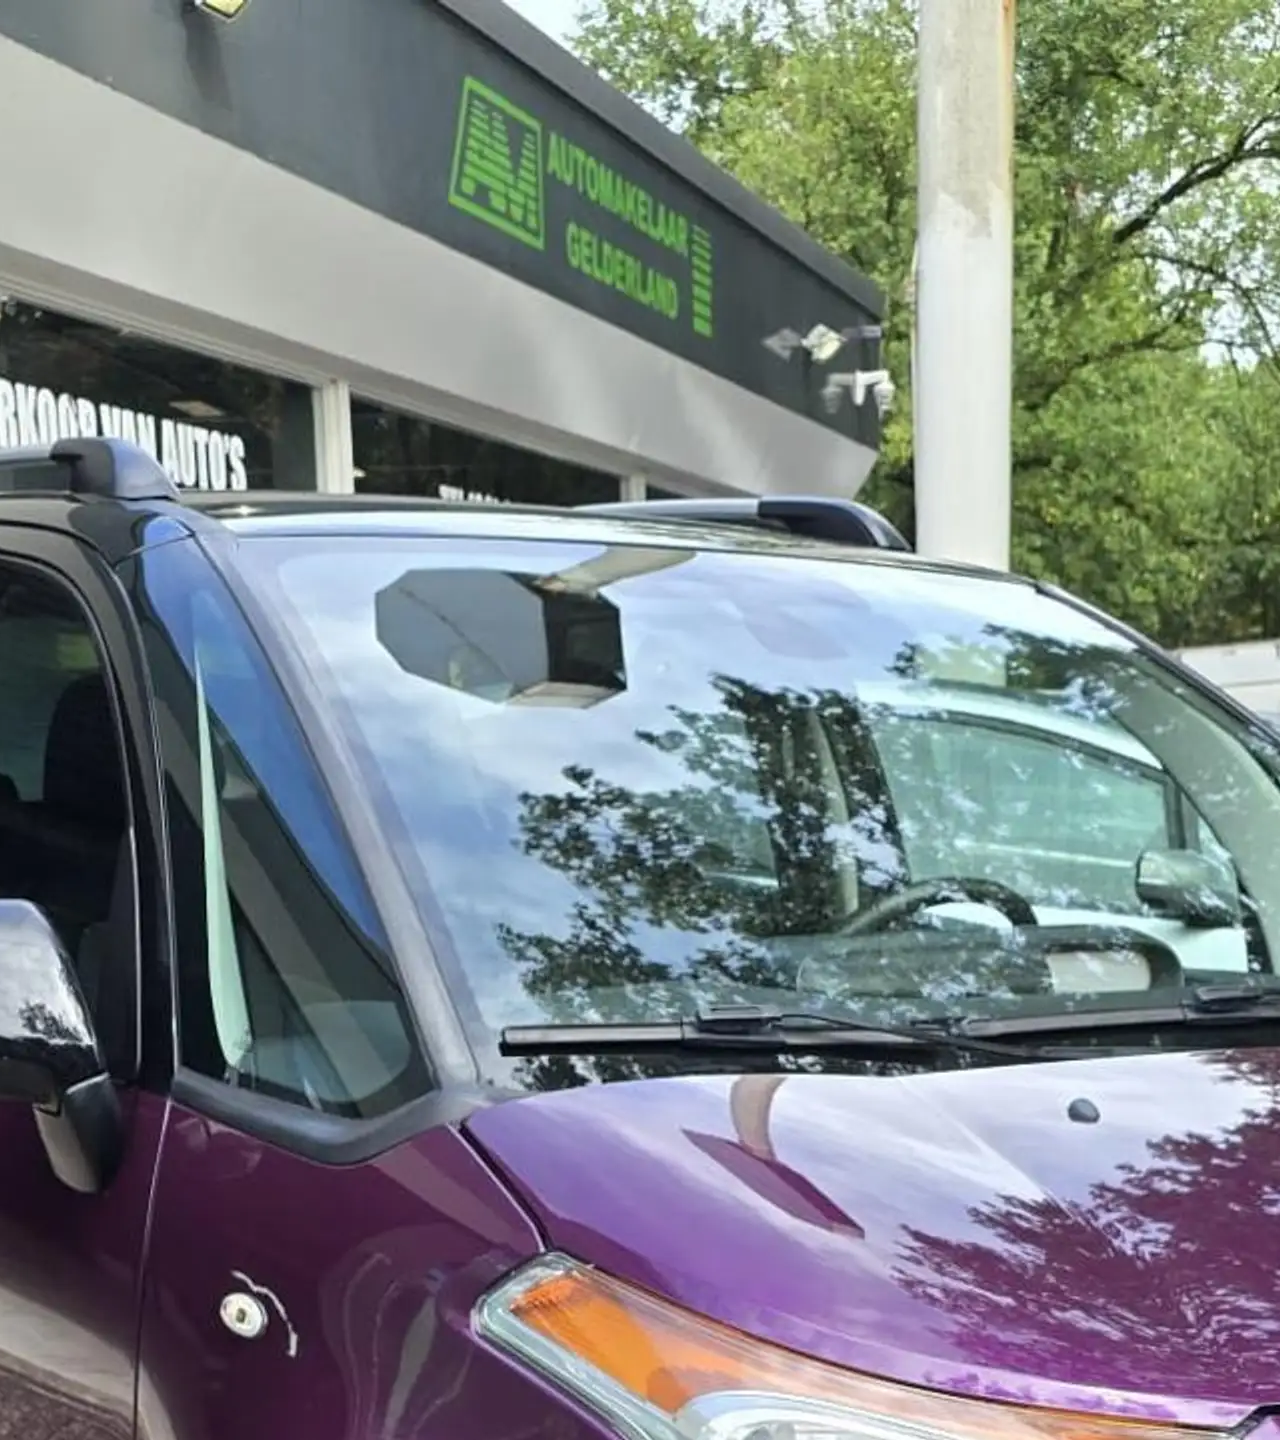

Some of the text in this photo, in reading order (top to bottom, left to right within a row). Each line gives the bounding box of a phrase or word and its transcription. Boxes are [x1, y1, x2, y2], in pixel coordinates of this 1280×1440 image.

[547, 131, 689, 257] AUTOMAKELAAR
[566, 221, 679, 320] GELDERLAND
[161, 418, 248, 491] AUTO'S
